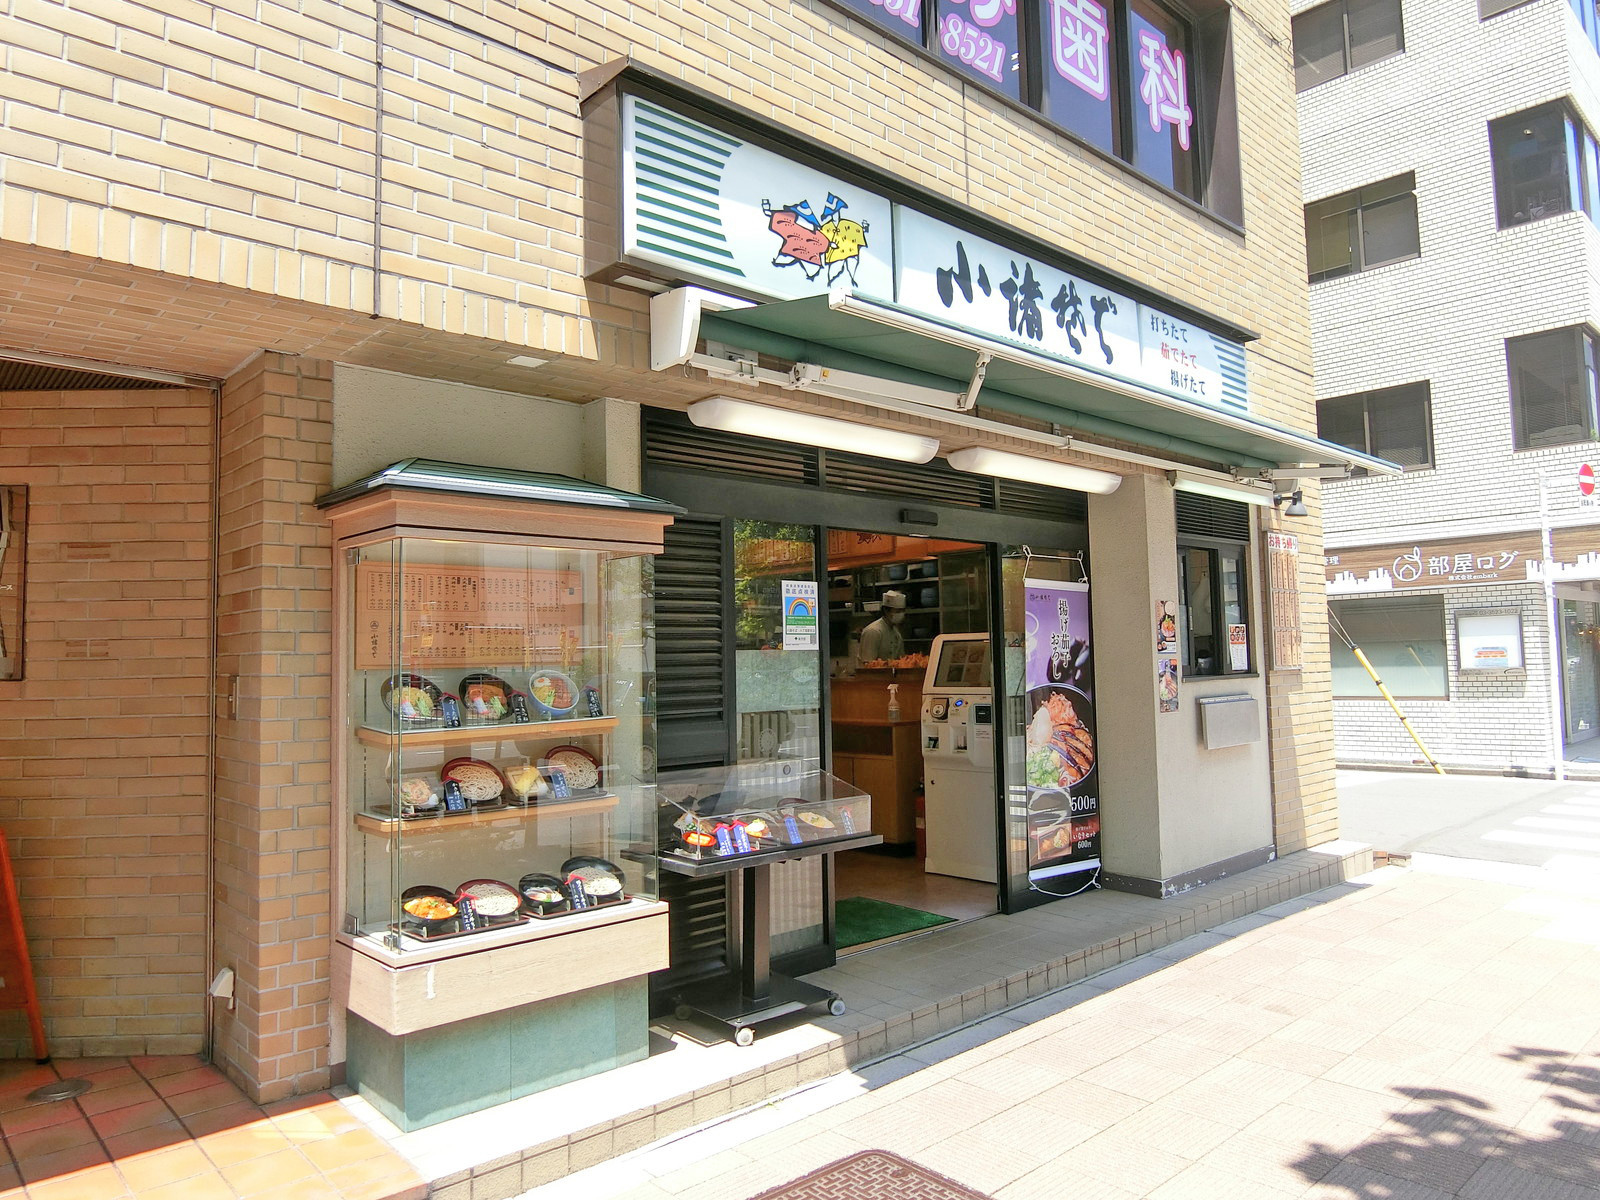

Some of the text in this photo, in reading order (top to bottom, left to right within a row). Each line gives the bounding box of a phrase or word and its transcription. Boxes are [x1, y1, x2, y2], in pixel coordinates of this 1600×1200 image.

[942, 17, 1002, 79] 8521
[1151, 314, 1188, 343] 打ちたて
[1161, 342, 1198, 370] 茹でたて
[1170, 369, 1206, 396] 揚げたて
[1427, 550, 1519, 575] 部屋ログ
[1059, 599, 1071, 668] 揚げ茄子
[1051, 633, 1061, 679] おろし
[1071, 795, 1096, 811] 500円
